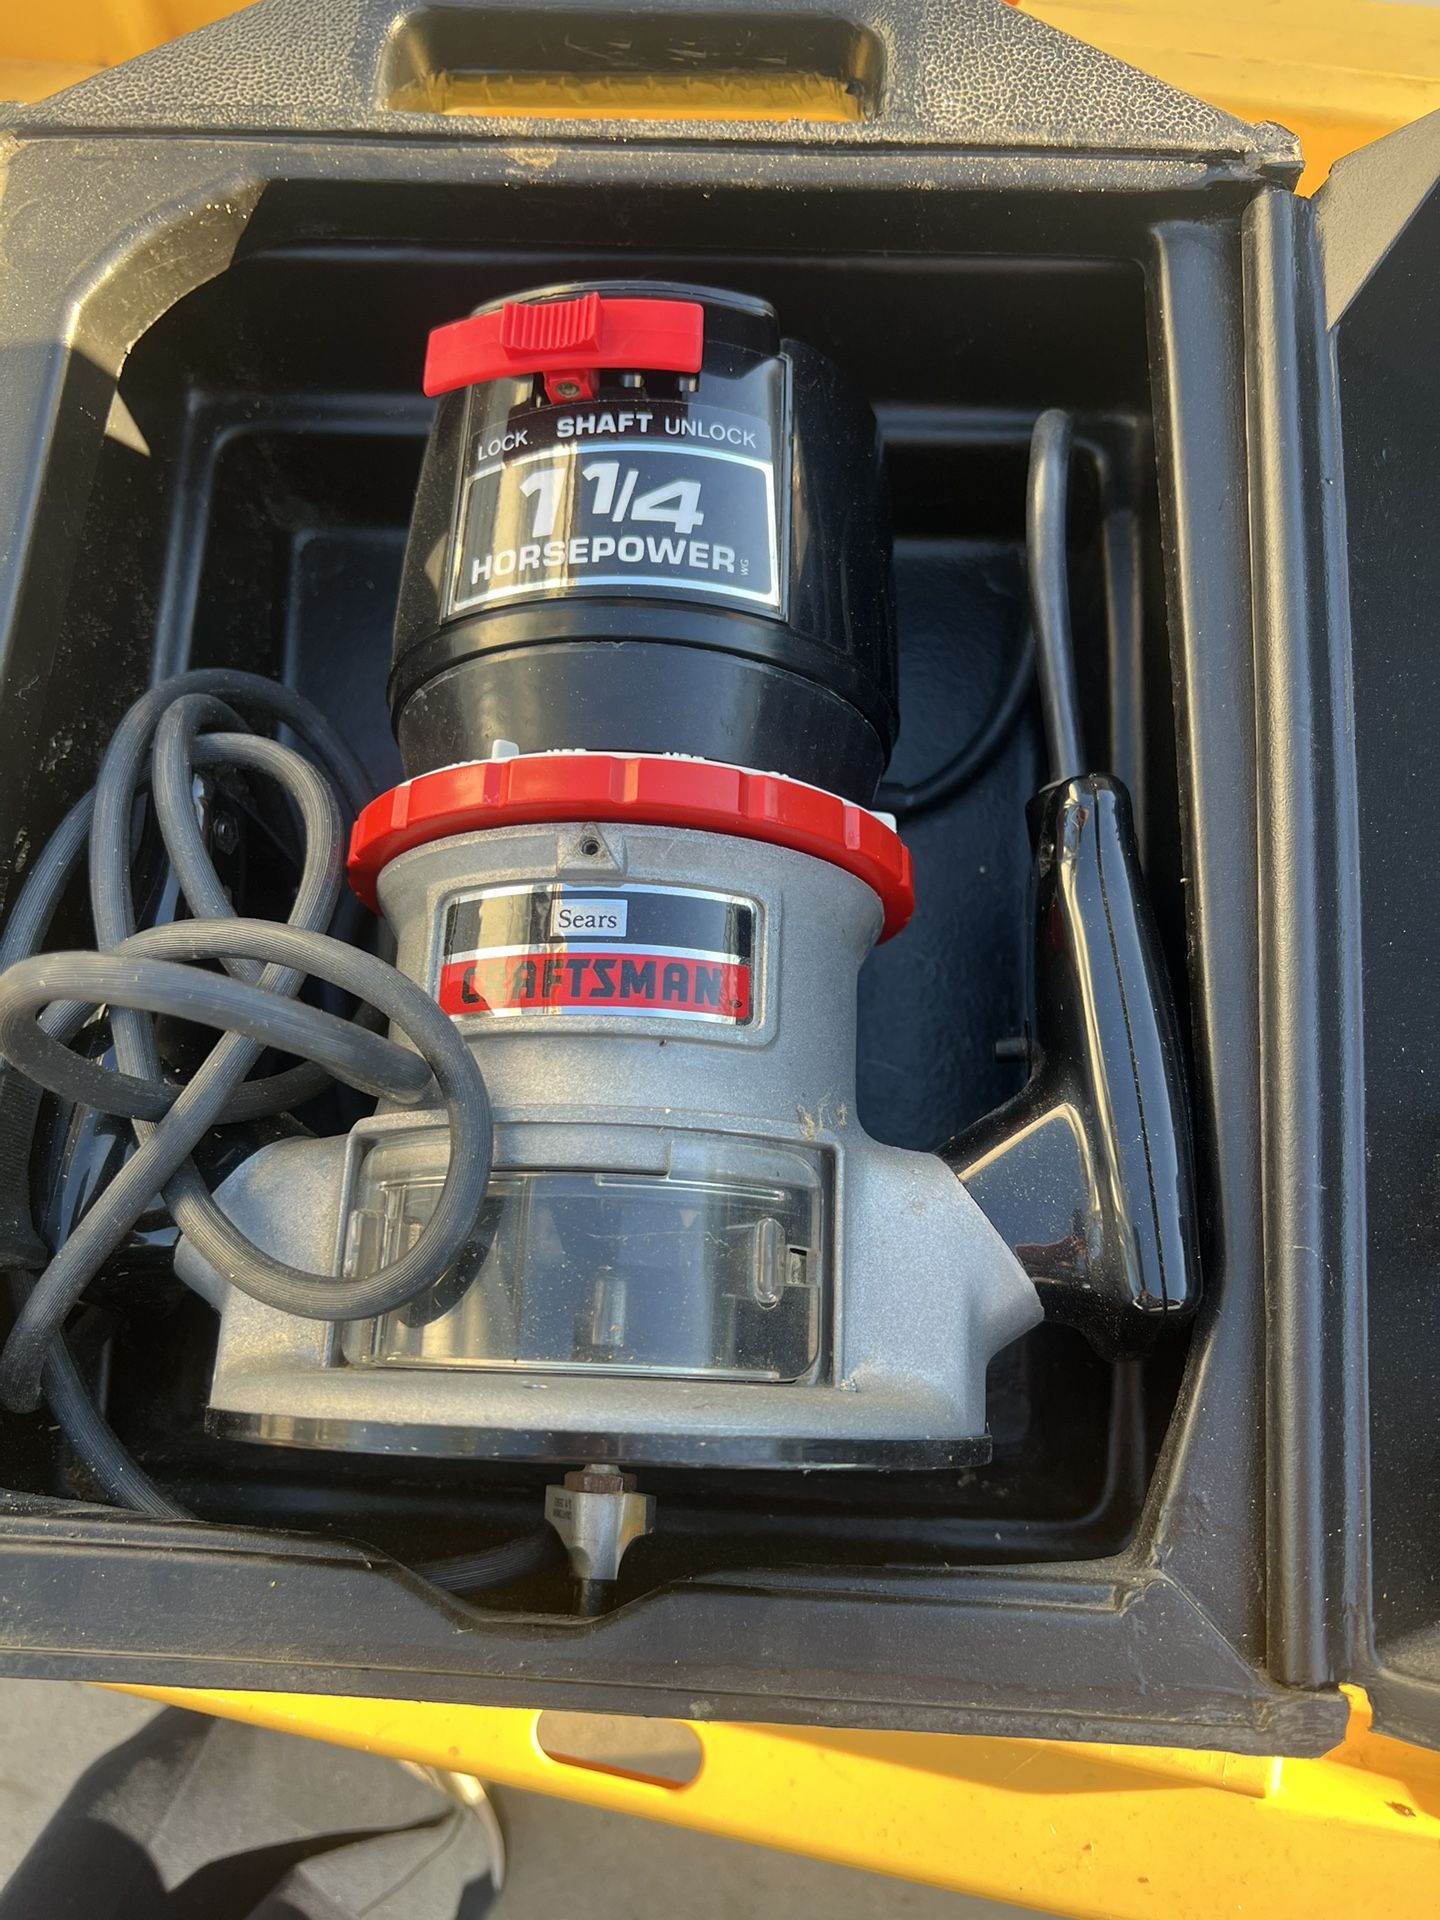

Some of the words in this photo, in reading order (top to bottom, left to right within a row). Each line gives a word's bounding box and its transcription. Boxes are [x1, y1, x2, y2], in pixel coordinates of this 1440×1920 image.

[477, 430, 529, 461] LOCK
[556, 411, 653, 438] SHAFT
[664, 415, 757, 449] UNLOCK
[519, 468, 566, 538] 1
[582, 459, 705, 535] 1/4
[471, 535, 736, 585] HORSEPOWER
[558, 909, 618, 929] Sears
